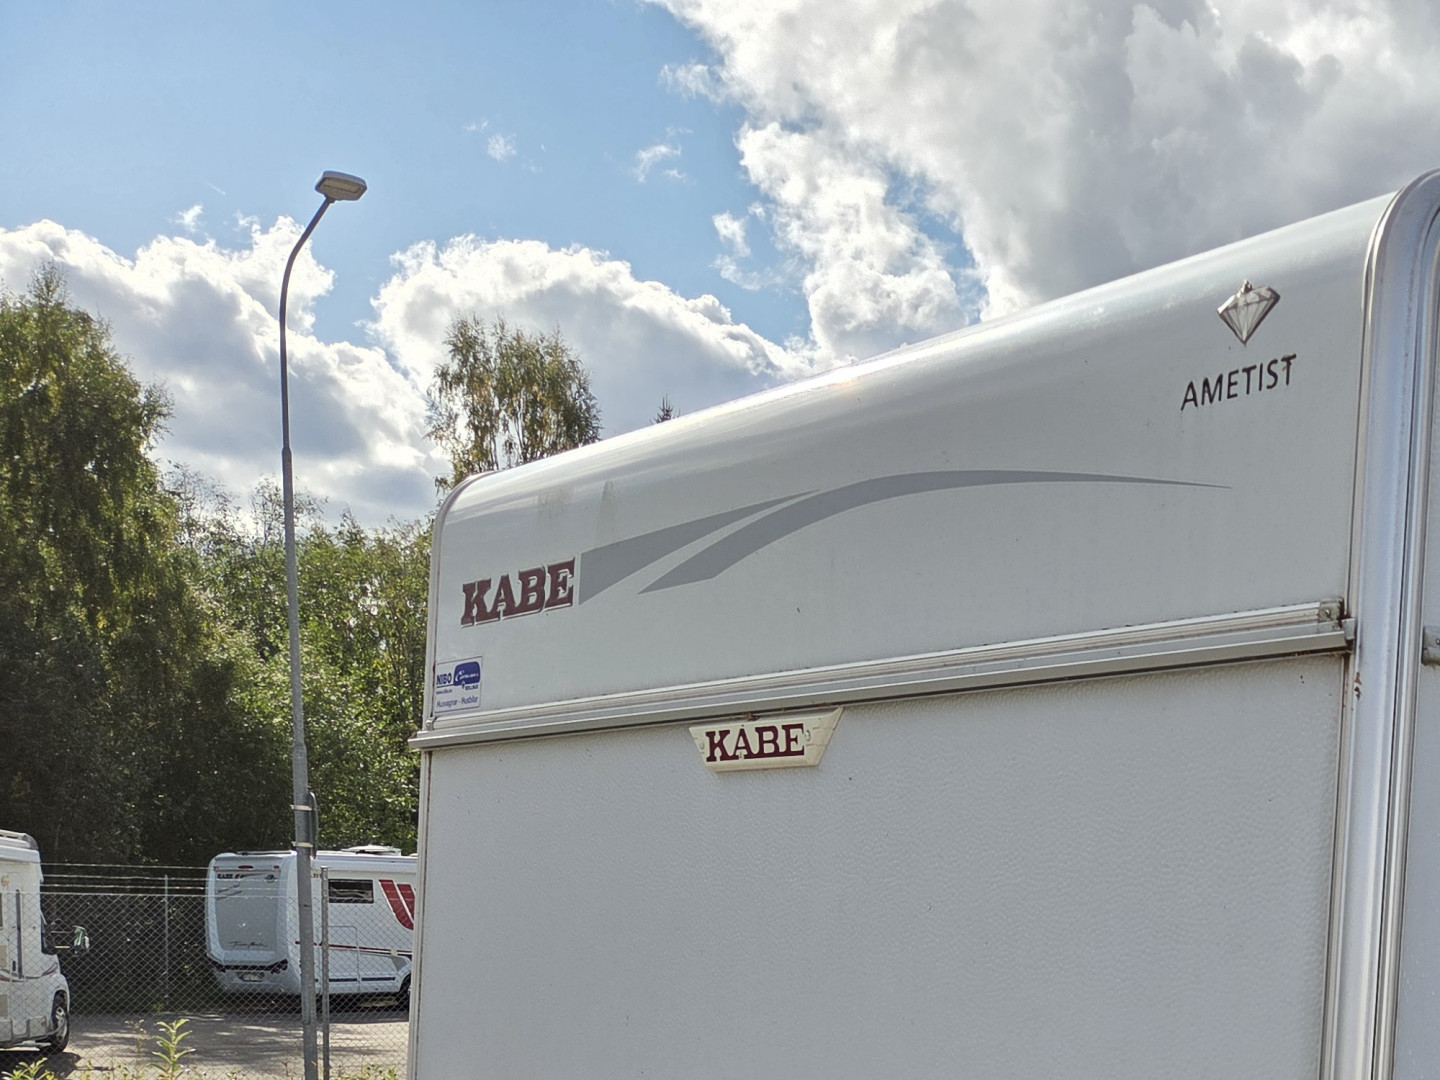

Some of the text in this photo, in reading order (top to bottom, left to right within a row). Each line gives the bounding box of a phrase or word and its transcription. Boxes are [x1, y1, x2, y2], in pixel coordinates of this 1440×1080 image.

[1180, 354, 1297, 411] AMETIST
[460, 556, 575, 627] KABE
[705, 723, 805, 763] KABE
